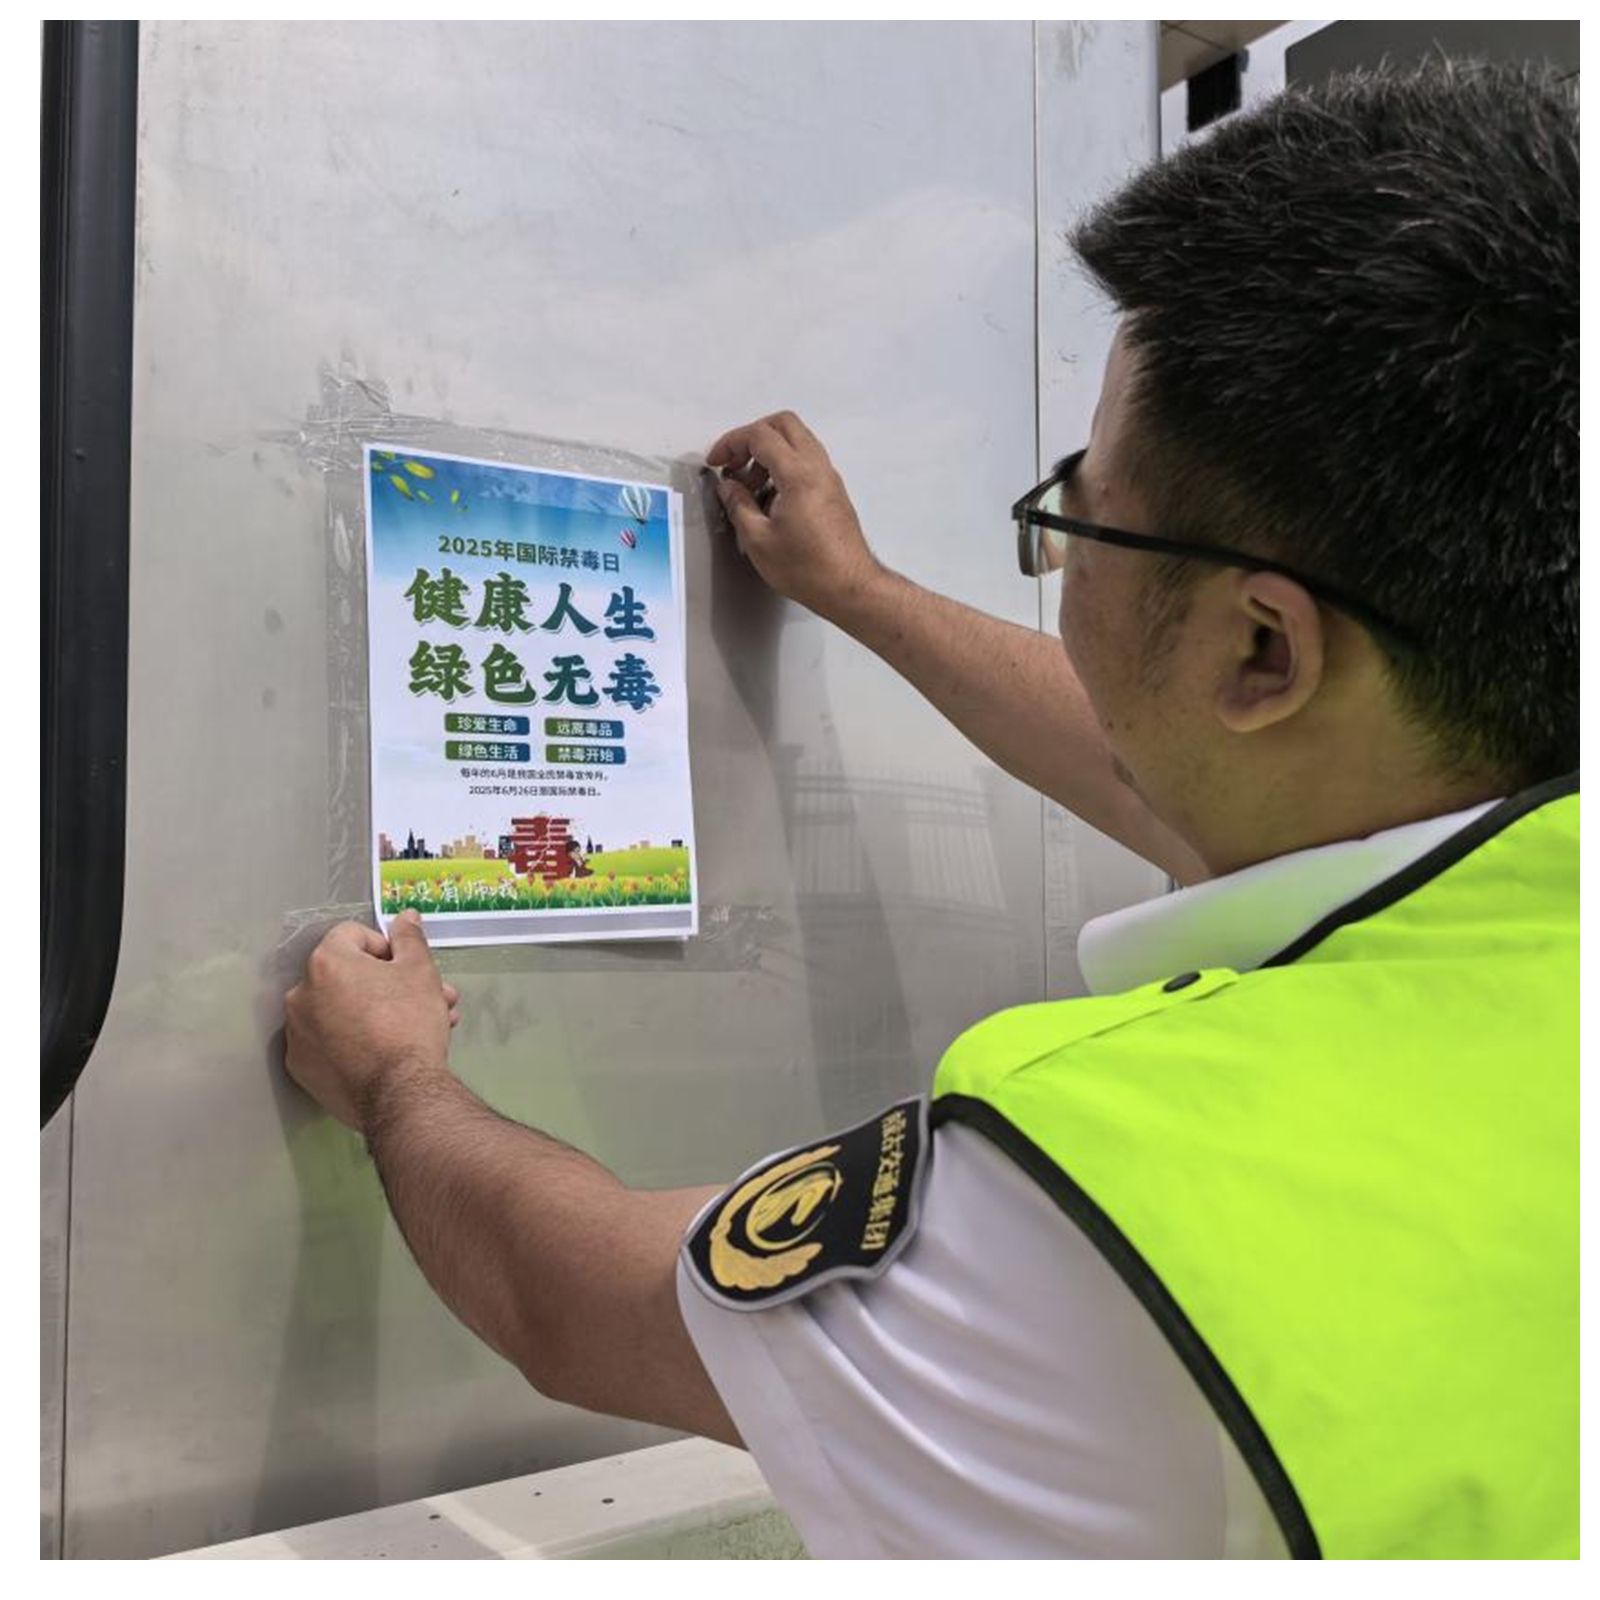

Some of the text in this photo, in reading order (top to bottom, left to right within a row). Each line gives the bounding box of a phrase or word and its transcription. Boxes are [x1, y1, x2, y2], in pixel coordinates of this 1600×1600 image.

[438, 534, 620, 574] 2025年国际禁毒日
[404, 567, 657, 642] 健康人生
[408, 641, 662, 711] 绿色无毒
[458, 716, 613, 737] 珍爱生命 远离毒品
[458, 744, 614, 762] 绿色生活 禁毒开始
